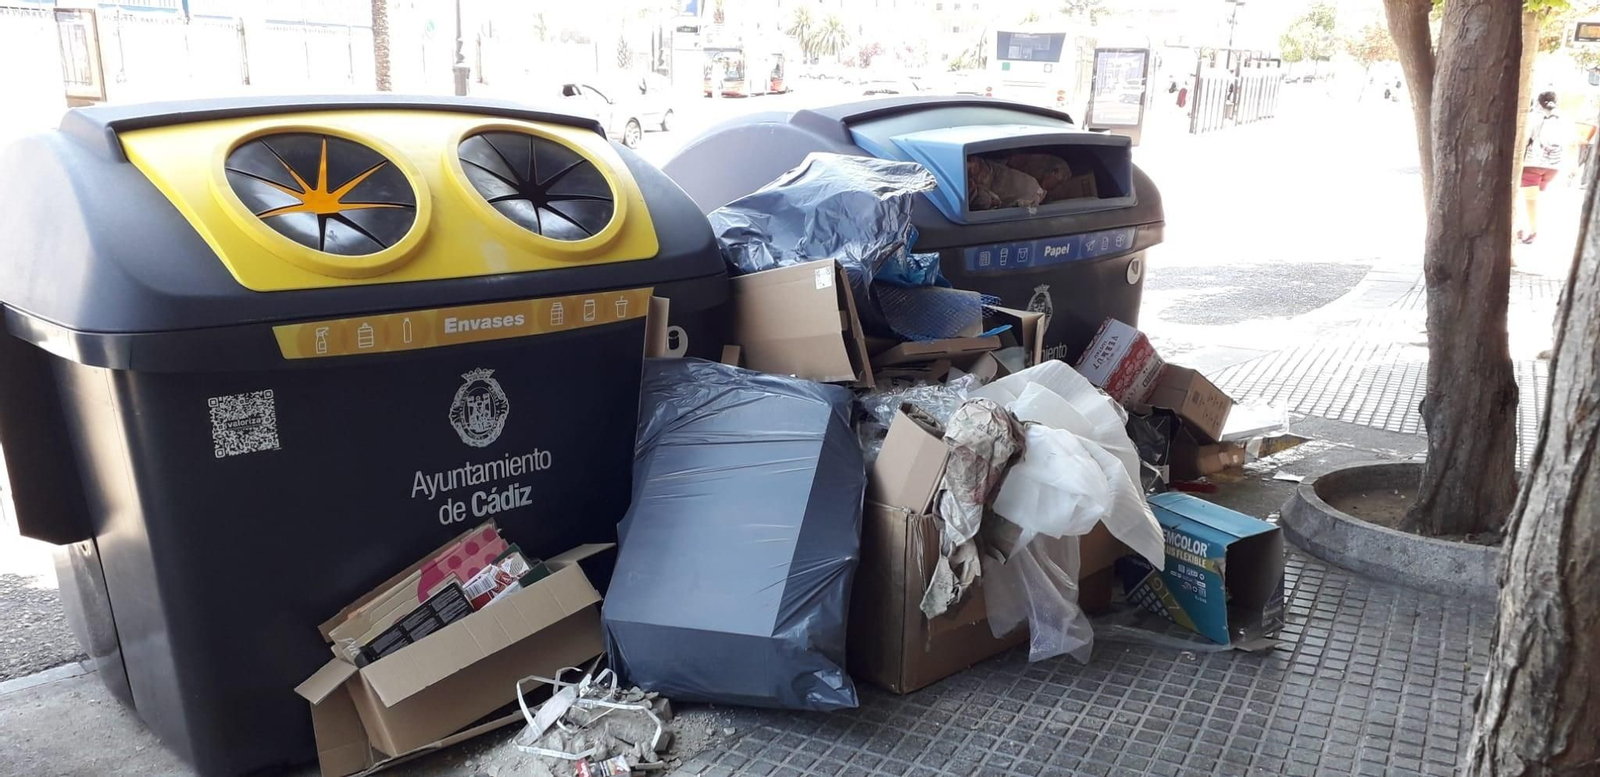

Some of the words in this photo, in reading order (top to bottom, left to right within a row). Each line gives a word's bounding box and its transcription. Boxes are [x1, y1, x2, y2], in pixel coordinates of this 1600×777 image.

[1044, 243, 1070, 258] Papel
[444, 313, 525, 334] Envases
[1093, 335, 1119, 370] VERMUT
[227, 417, 261, 428] valoriza
[411, 447, 552, 501] Ayuntamiento
[438, 498, 467, 525] de
[471, 482, 533, 517] Cádiz
[1163, 528, 1207, 558] EMCOLOR
[1164, 545, 1176, 556] LUS
[1176, 550, 1206, 569] FLEXIBLE
